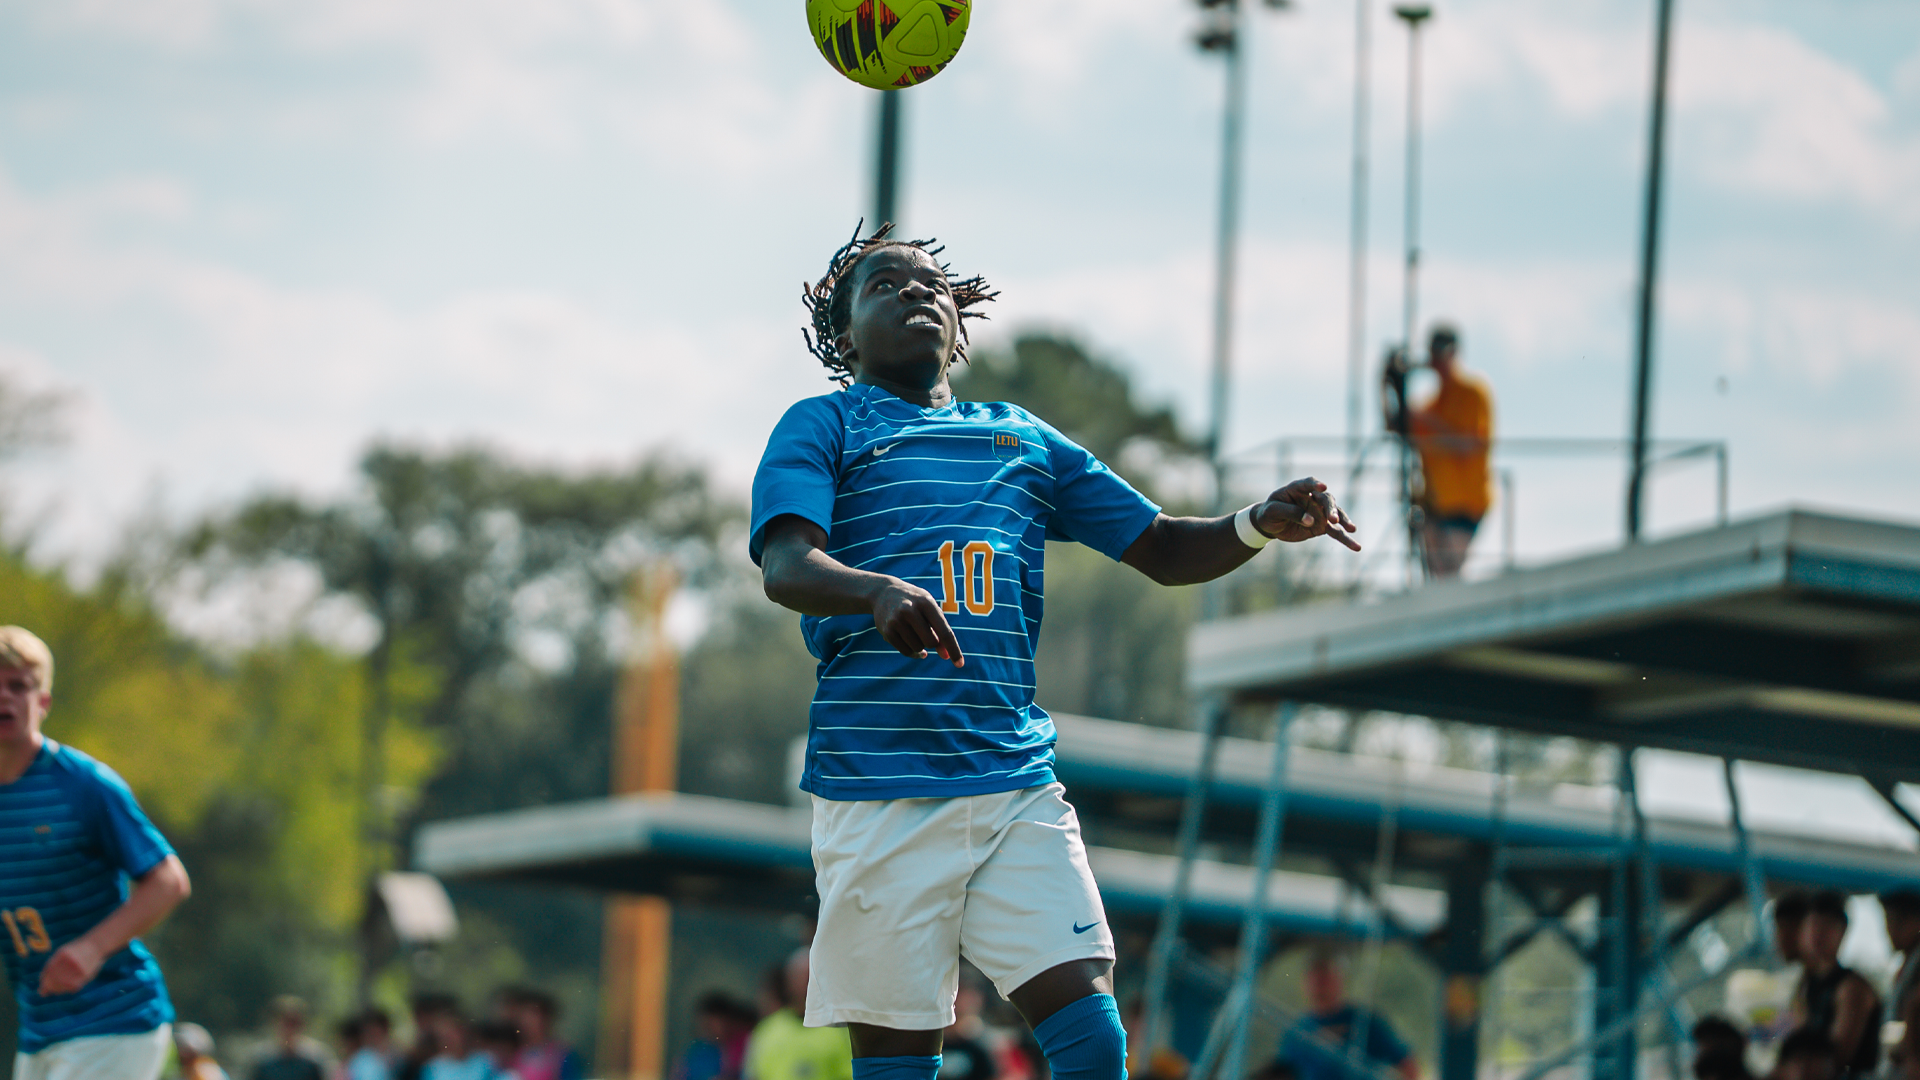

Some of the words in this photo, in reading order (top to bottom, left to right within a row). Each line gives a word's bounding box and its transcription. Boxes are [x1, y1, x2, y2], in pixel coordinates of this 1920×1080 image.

[996, 434, 1018, 447] LETU
[937, 540, 994, 617] 10
[1, 906, 51, 957] 13
